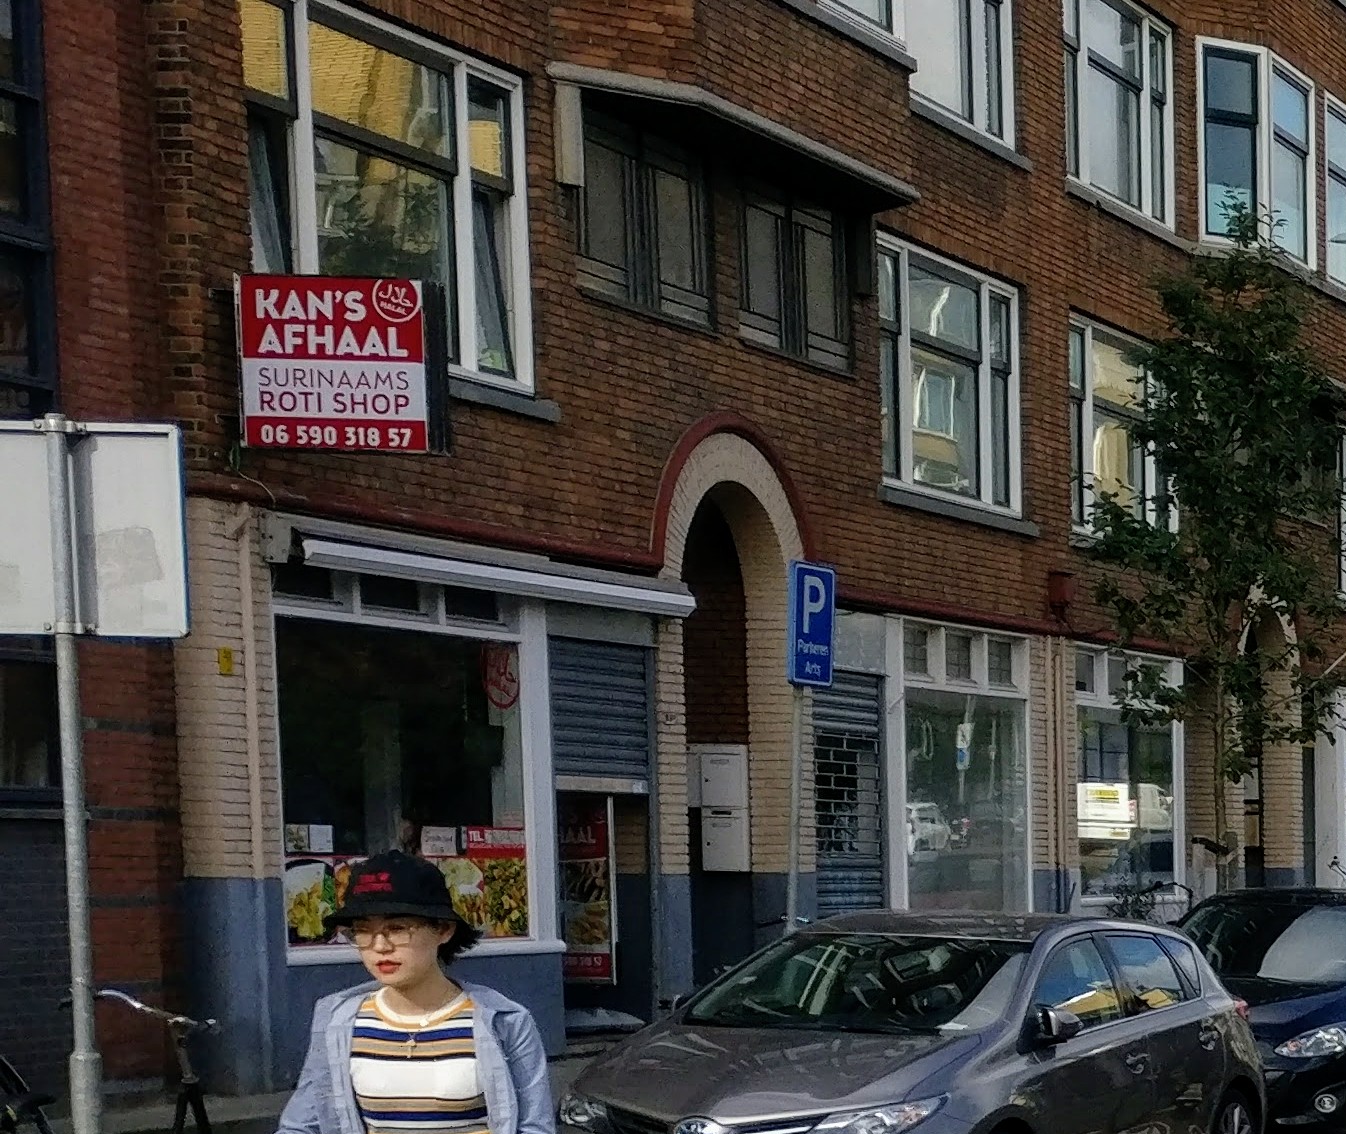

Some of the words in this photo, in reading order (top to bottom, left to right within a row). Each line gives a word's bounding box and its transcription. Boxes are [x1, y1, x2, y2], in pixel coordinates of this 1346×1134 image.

[255, 289, 367, 322] KAN'S
[257, 324, 408, 357] AFHAAL
[258, 367, 409, 390] SURINAAMS
[260, 391, 322, 413] ROTI
[333, 393, 410, 415] SHOP
[261, 424, 289, 444] 06
[297, 425, 338, 445] 590
[344, 426, 381, 447] 318
[388, 428, 412, 447] 57
